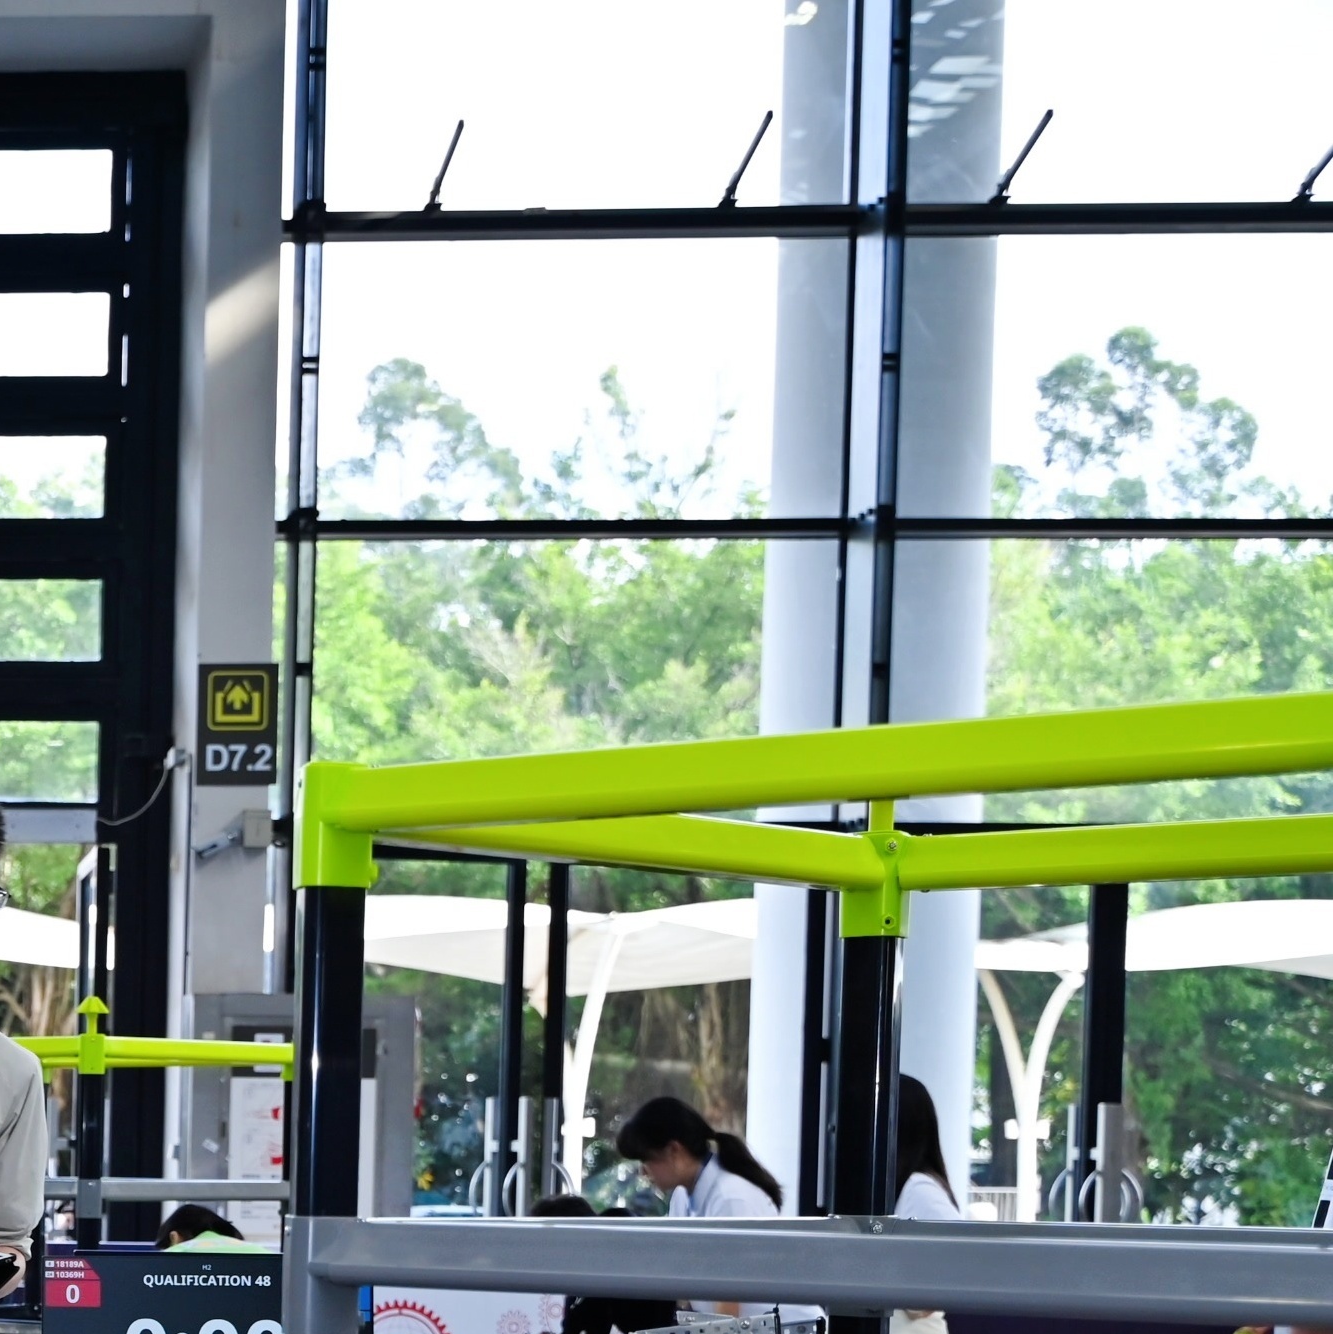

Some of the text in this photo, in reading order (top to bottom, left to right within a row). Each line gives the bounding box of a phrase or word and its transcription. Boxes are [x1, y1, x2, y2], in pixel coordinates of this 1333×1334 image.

[205, 744, 272, 771] D7.2
[55, 1260, 84, 1268] 18189A
[55, 1271, 85, 1279] 10369H
[143, 1274, 271, 1288] QUALIFICATION 48
[65, 1284, 80, 1304] 0
